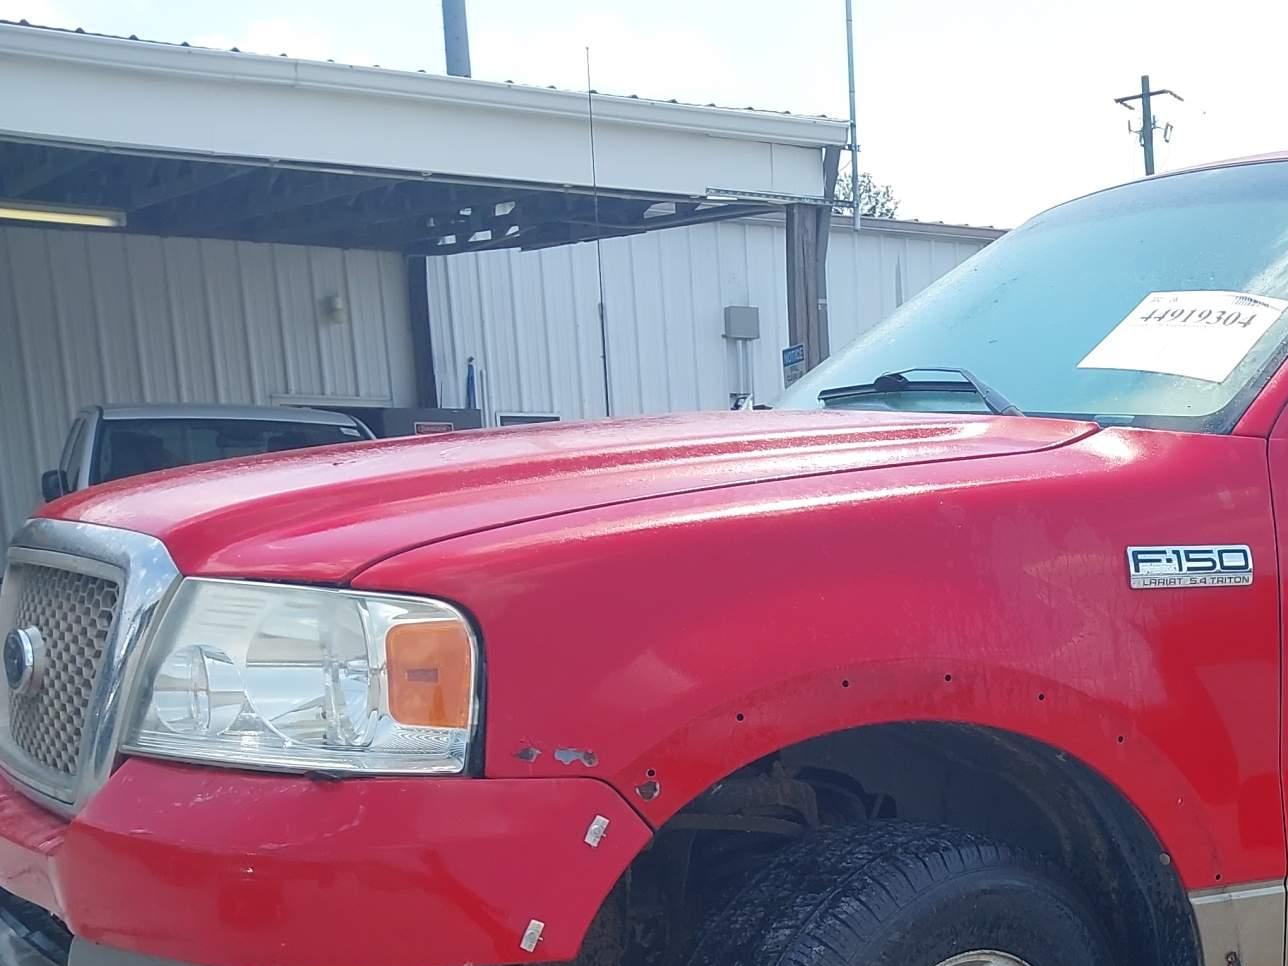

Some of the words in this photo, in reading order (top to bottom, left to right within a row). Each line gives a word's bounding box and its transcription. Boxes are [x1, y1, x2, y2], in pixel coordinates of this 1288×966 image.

[1140, 308, 1257, 329] 44919304
[1142, 577, 1183, 587] LARIAT
[1189, 577, 1207, 585] 5.4
[1210, 576, 1250, 585] TRITON
